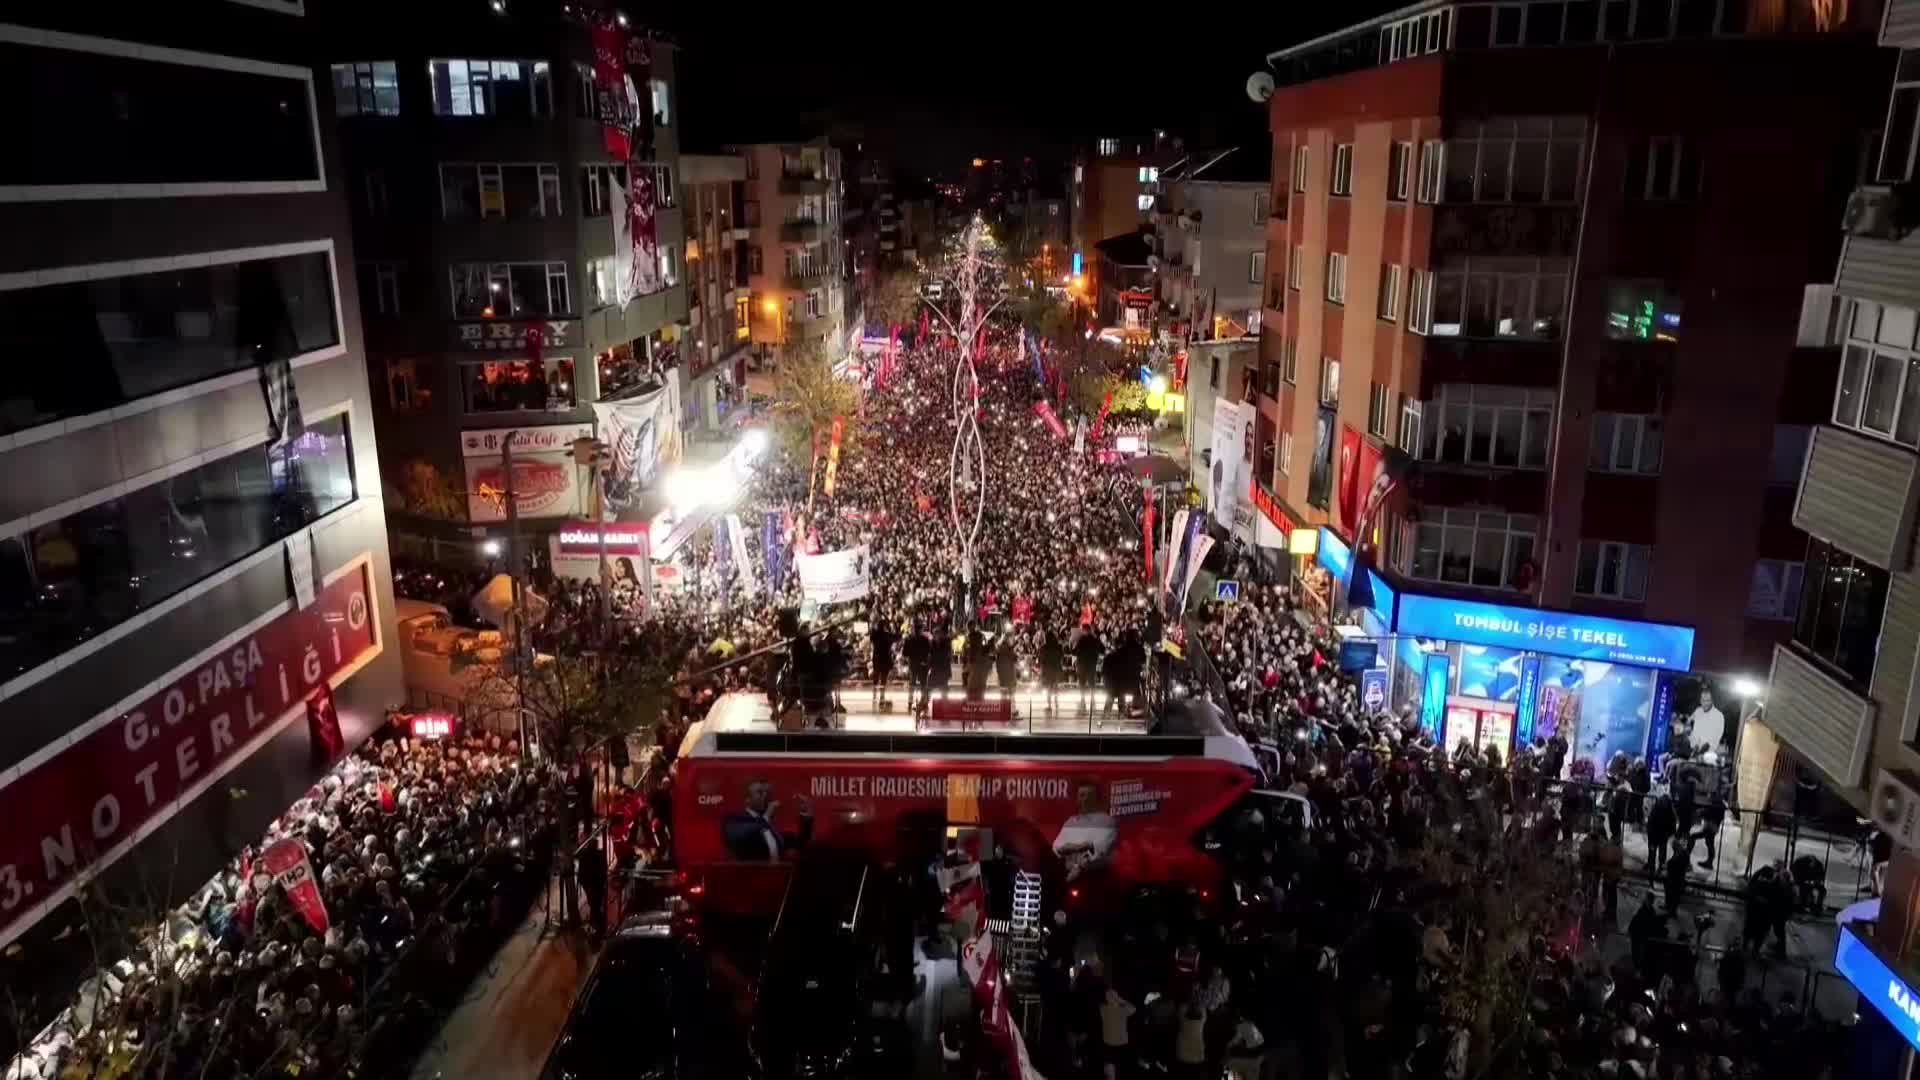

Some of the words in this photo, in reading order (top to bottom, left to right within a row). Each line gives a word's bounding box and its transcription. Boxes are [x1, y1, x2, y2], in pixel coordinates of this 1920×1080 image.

[1454, 612, 1522, 634] TOMBUL
[1527, 620, 1567, 640] ŞİŞE
[1572, 628, 1629, 648] TEKEL
[810, 775, 867, 797] MİLLET
[871, 775, 950, 799] İRADESİNE
[1006, 777, 1069, 800] ÇIKIYOR
